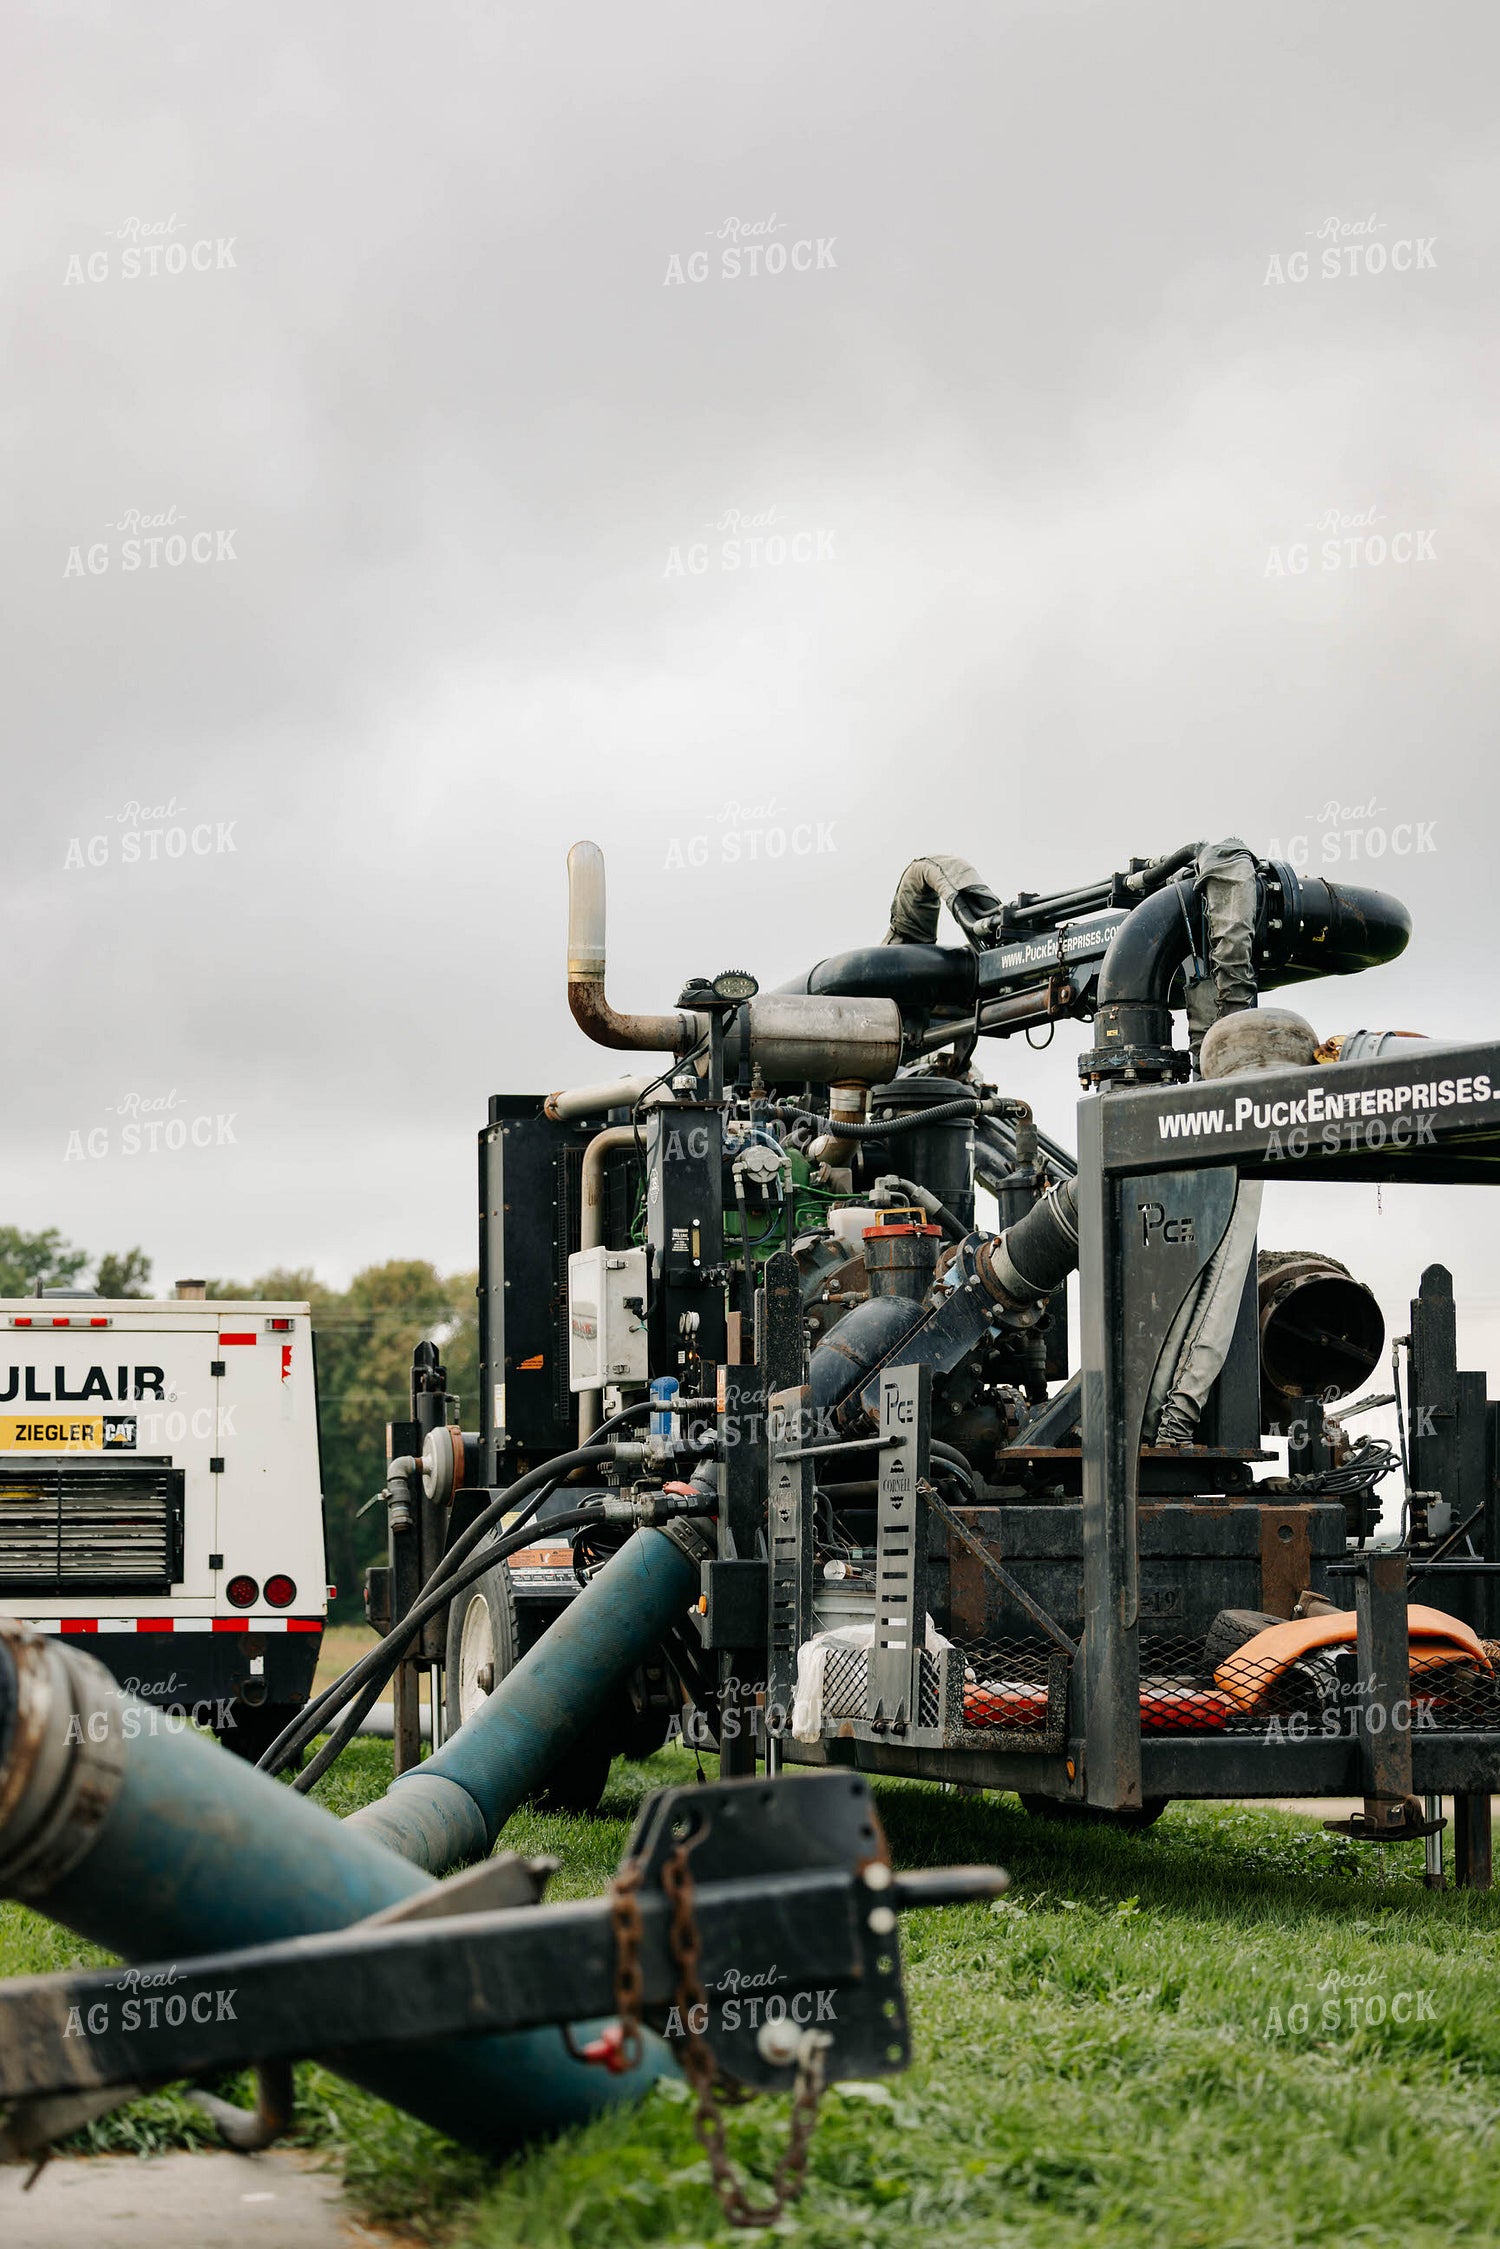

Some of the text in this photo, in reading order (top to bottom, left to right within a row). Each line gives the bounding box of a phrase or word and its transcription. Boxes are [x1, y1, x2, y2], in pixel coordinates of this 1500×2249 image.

[15, 1424, 95, 1442] ZIEGLER
[105, 1423, 135, 1442] CAT
[882, 1478, 911, 1493] CORNELL
